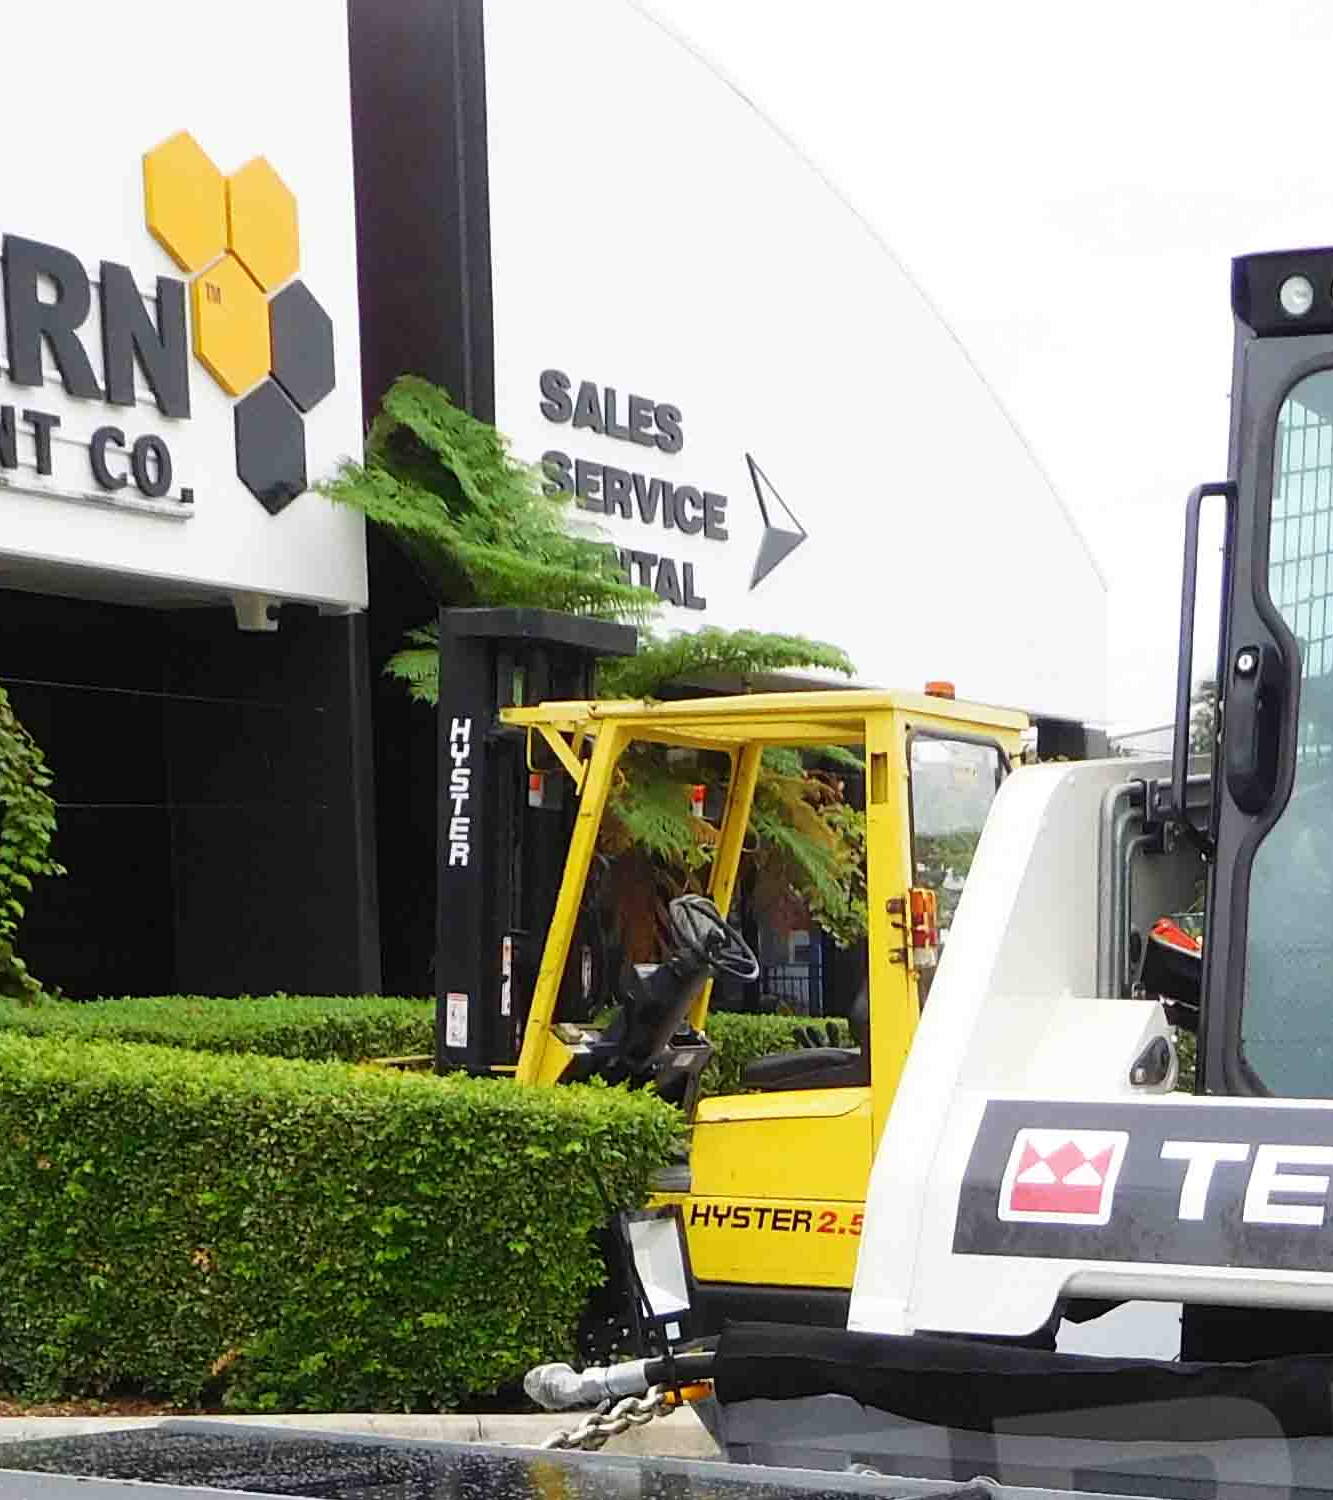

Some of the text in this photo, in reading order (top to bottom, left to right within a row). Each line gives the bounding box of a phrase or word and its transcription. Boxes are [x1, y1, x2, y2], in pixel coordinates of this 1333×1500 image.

[539, 369, 683, 454] SALES
[90, 425, 195, 505] CO.
[542, 450, 729, 541] SERVICE
[449, 718, 472, 866] HYSTER
[690, 1203, 813, 1233] HYSTER
